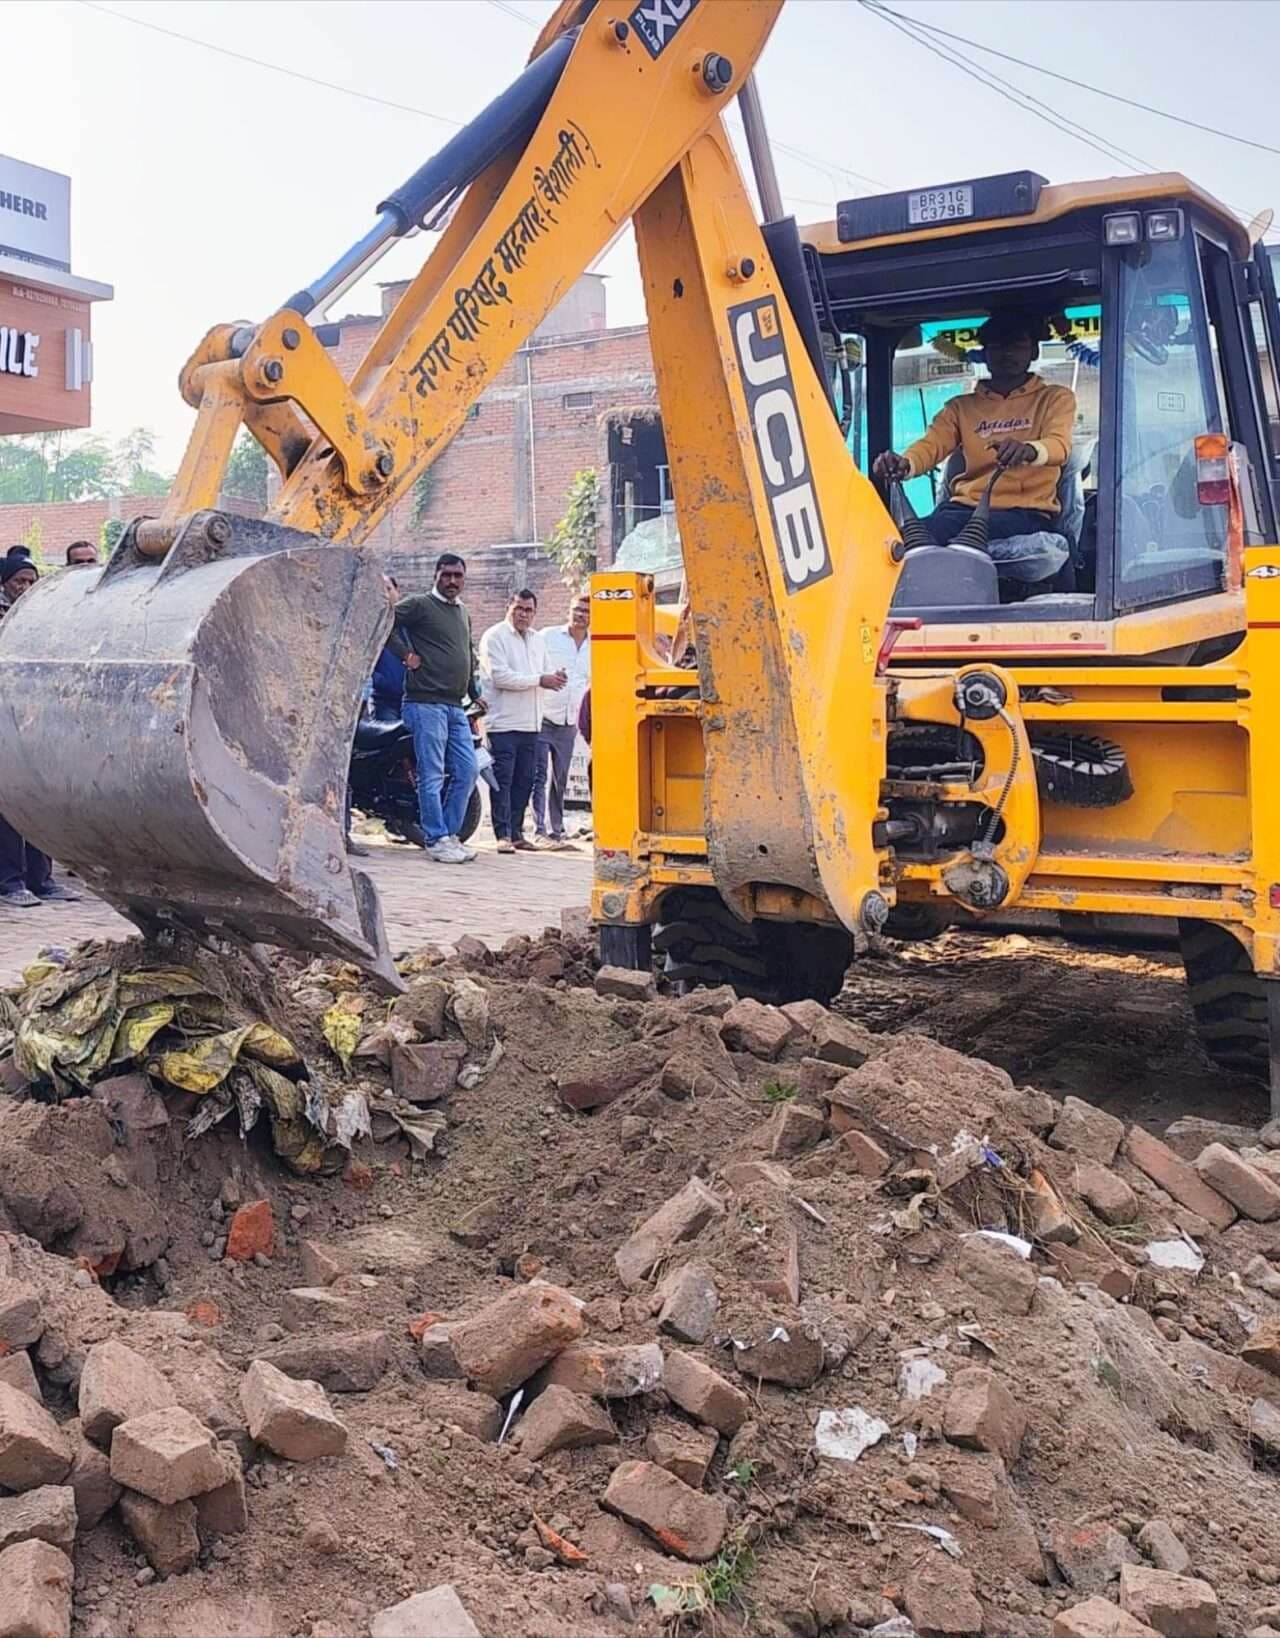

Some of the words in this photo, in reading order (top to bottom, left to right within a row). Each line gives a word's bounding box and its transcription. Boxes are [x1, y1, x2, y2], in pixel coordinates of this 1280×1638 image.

[634, 13, 661, 51] PLUS
[920, 191, 965, 208] BR31G
[920, 204, 965, 221] C3796
[409, 327, 462, 398] नगर
[735, 310, 826, 584] JCB
